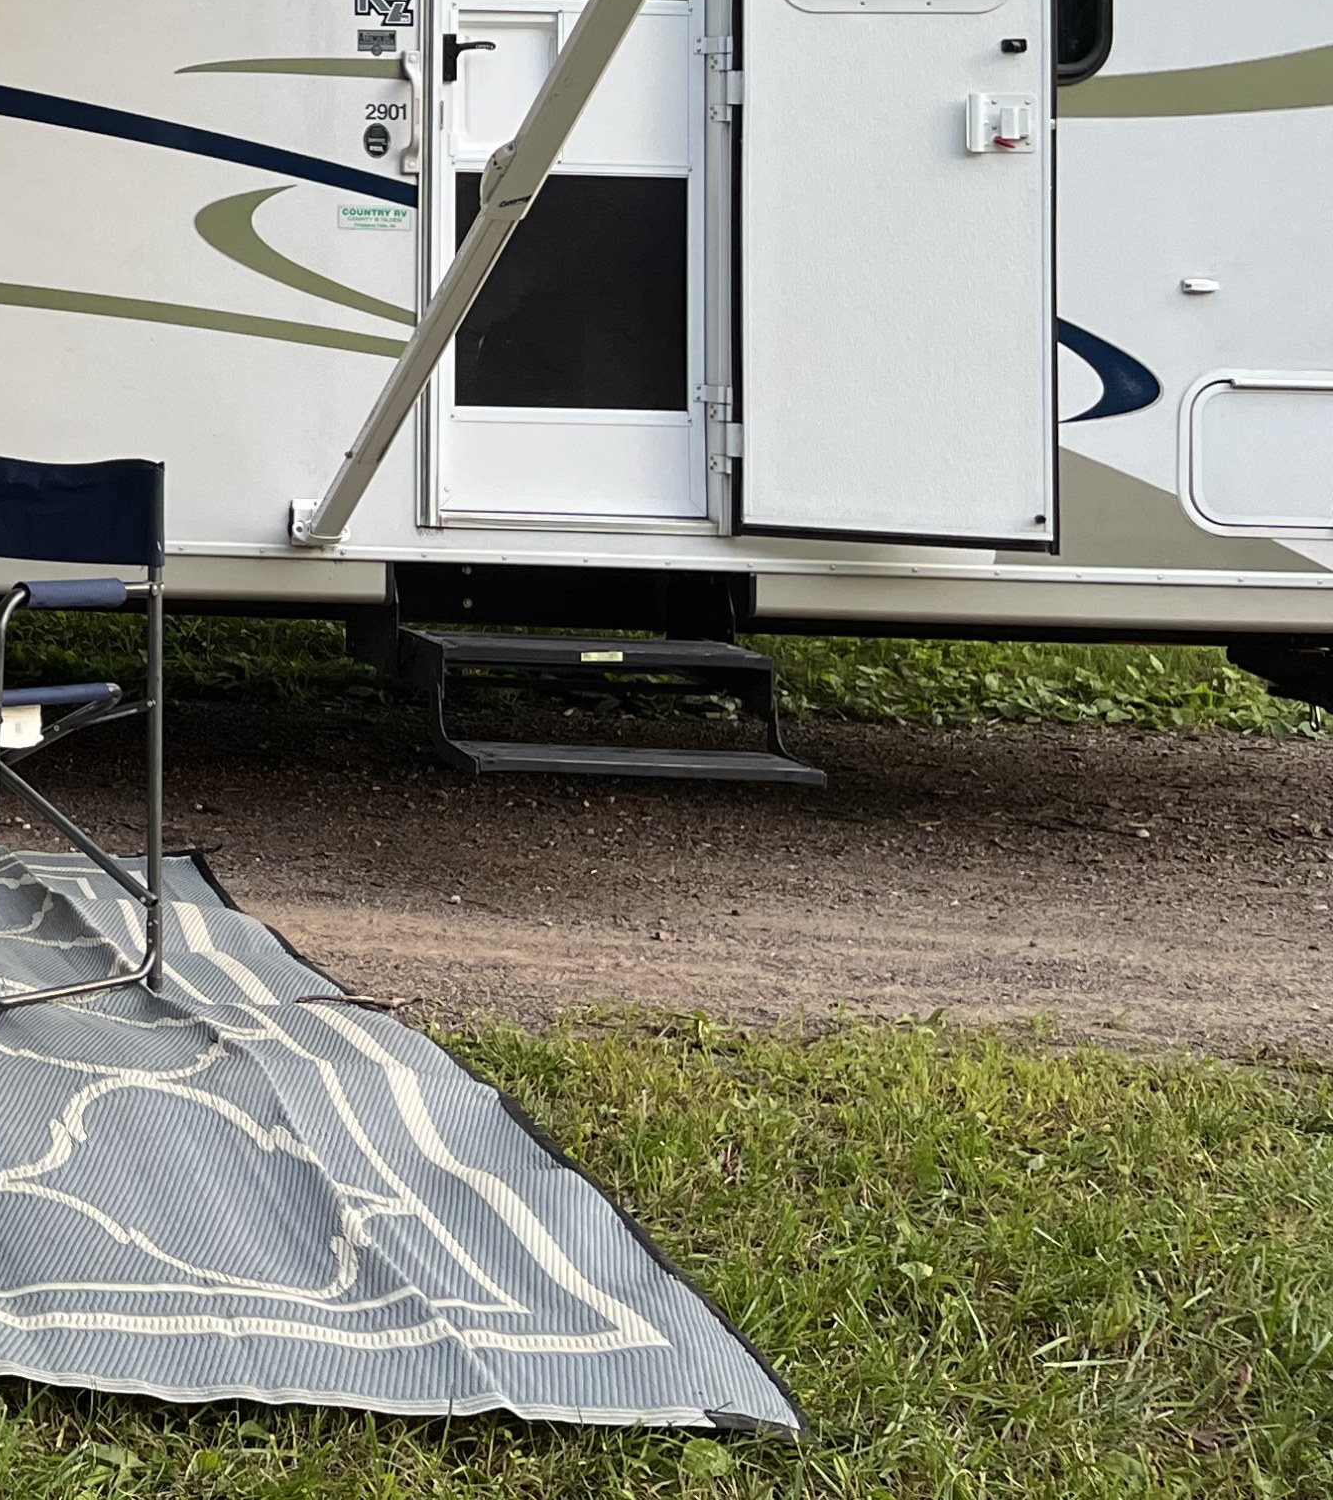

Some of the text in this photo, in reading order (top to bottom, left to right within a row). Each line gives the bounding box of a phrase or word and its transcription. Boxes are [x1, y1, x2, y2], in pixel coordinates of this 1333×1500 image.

[365, 103, 407, 121] 2901
[342, 208, 407, 217] COUNTRY RV
